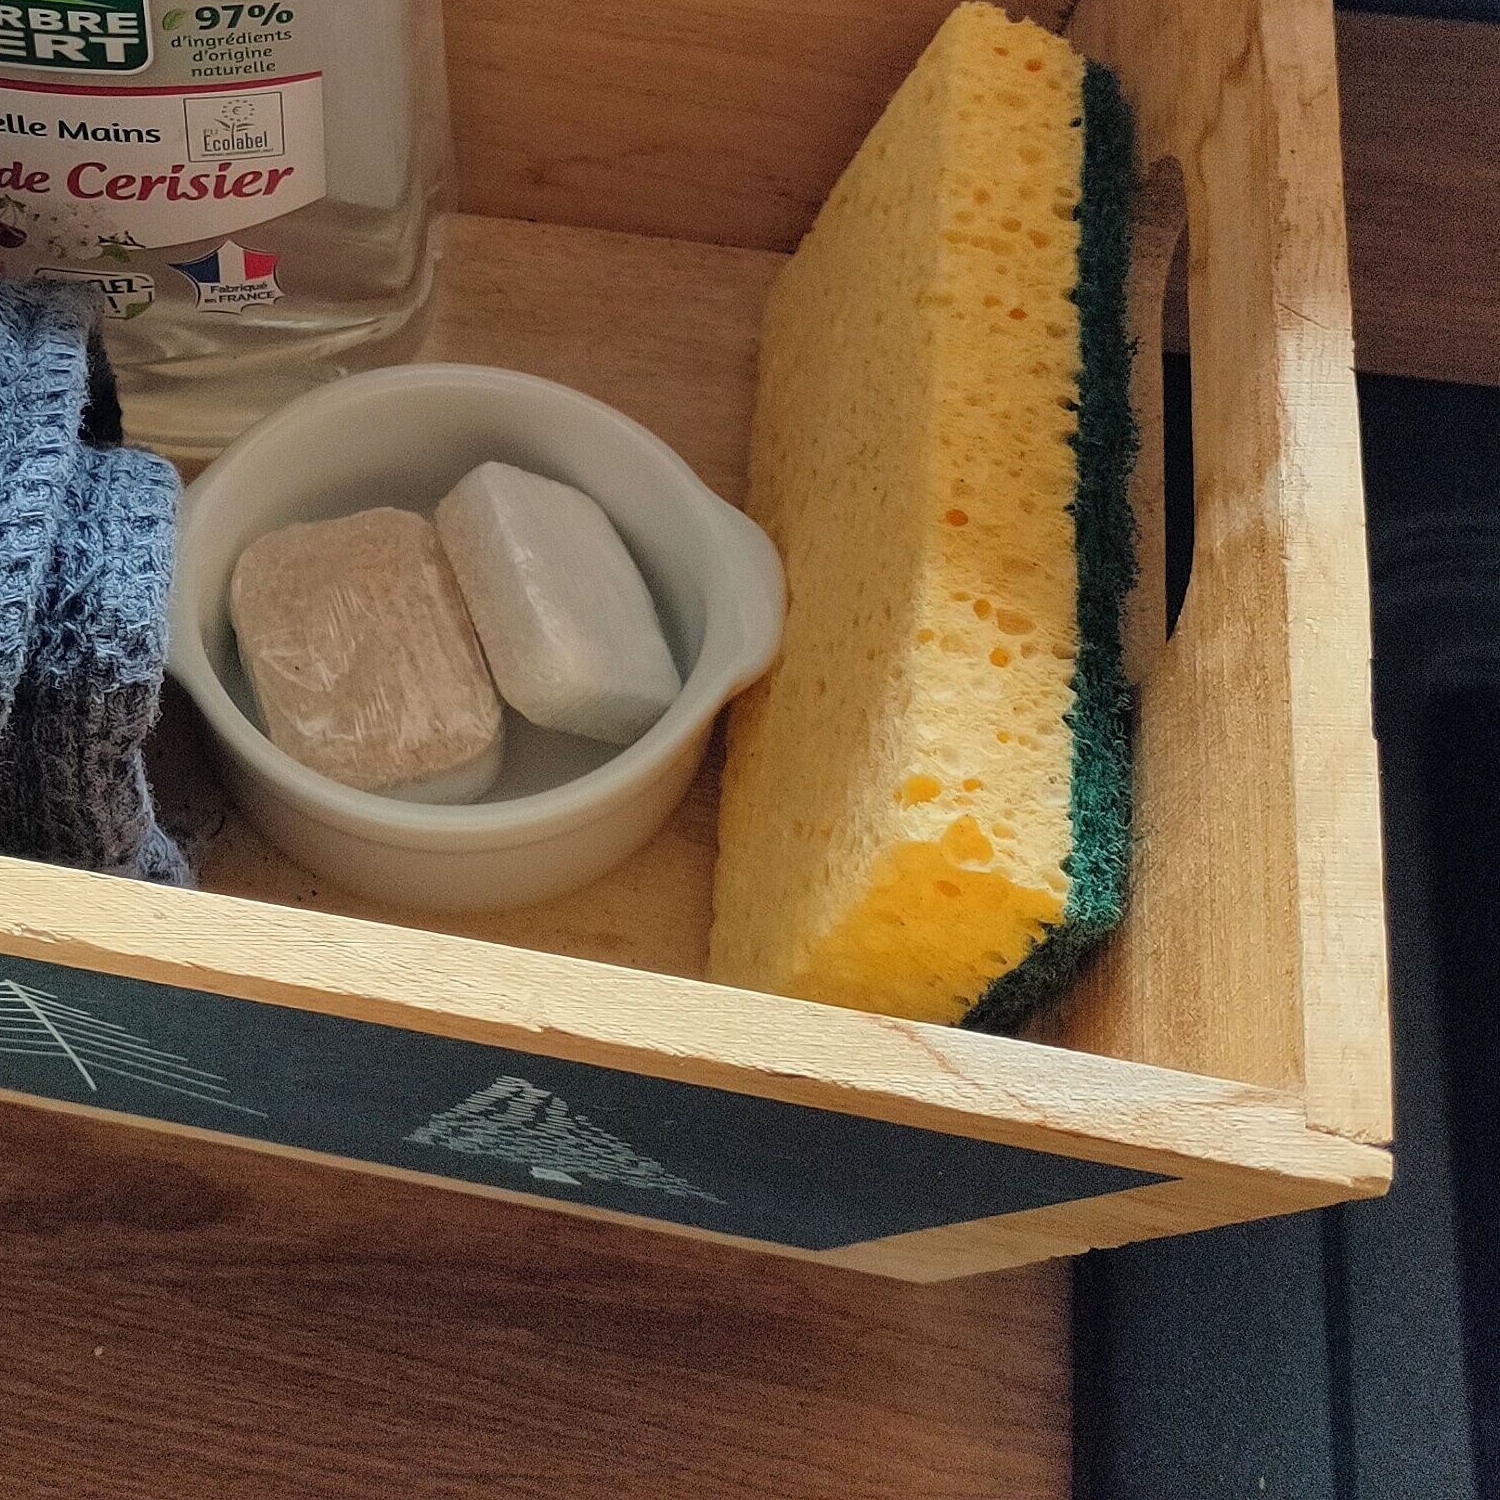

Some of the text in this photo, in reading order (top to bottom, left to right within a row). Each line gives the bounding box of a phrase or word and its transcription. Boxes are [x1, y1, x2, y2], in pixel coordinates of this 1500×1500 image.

[195, 2, 294, 31] 97%
[171, 30, 293, 50] d'ingrédients
[192, 47, 273, 63] d'origine
[191, 61, 276, 77] naturelle
[58, 120, 162, 145] Mains
[204, 130, 268, 152] Ecolabel
[66, 161, 295, 202] Cerisier
[211, 282, 269, 294] Fabriqué
[219, 290, 276, 303] FRANCE
